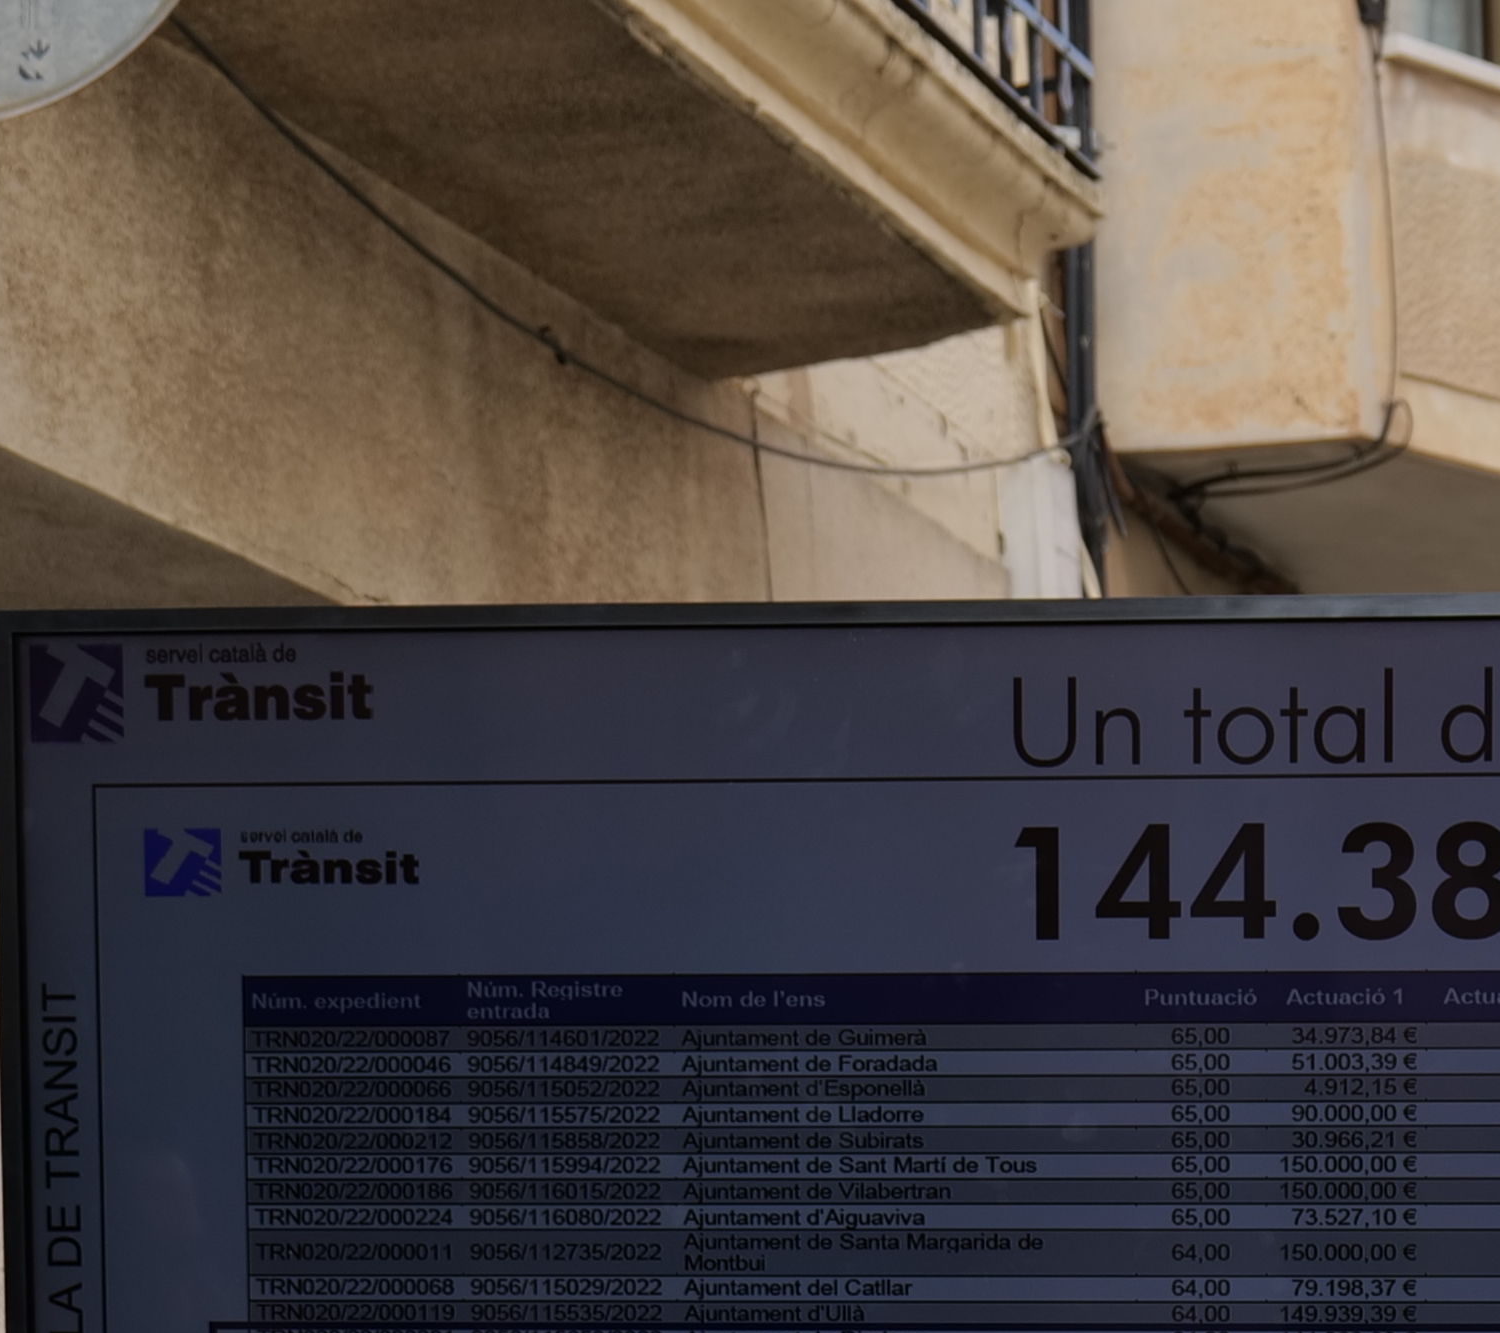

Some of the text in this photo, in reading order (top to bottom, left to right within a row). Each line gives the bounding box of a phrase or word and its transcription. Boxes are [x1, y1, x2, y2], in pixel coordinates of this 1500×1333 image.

[145, 642, 297, 665] servei català de
[144, 670, 376, 721] Trànsit
[1010, 676, 1144, 769] Un
[1182, 667, 1394, 765] total
[290, 829, 339, 844] català
[343, 829, 364, 844] de
[238, 849, 421, 885] Trànsit
[466, 979, 623, 1001] Núm. Registre
[681, 990, 732, 1009] Nom
[738, 990, 768, 1008] de
[1143, 987, 1258, 1007] Puntuació
[1286, 987, 1404, 1007] Actuació 1
[250, 991, 422, 1014] Núm. expedient
[466, 1002, 550, 1021] entrada
[251, 1056, 452, 1074] TRN020/22/000046
[466, 1056, 660, 1074] 9056/114849/2022
[681, 1055, 938, 1077] Ajuntament de Foradada
[1170, 1053, 1231, 1074] 65,00
[1291, 1053, 1418, 1074] 51.003,39 €
[41, 982, 81, 1190] TRANSIT
[253, 1157, 454, 1175] TRN020/22/000176
[468, 1157, 661, 1175] 9056/115994/2022
[682, 1157, 1038, 1179] Ajuntament de Sant Martí de Tous
[1170, 1156, 1231, 1177] 65,00
[1279, 1156, 1418, 1177] 150.000,00 €
[254, 1209, 454, 1227] TRN020/22/000224
[469, 1209, 662, 1227] 9056/116080/2022
[682, 1209, 926, 1231] Ajuntament d'Aiguaviva
[1171, 1208, 1231, 1229] 65,00
[1291, 1208, 1417, 1229] 73.527,10 €
[47, 1202, 83, 1269] DE
[683, 1254, 767, 1272] Montbui
[255, 1278, 455, 1296] TRN020/22/000068
[469, 1278, 663, 1296] 9056/115029/2022
[683, 1279, 914, 1301] Ajuntament del Catllar
[1171, 1279, 1231, 1300] 64,00
[1291, 1279, 1417, 1300] 79.198,37 €
